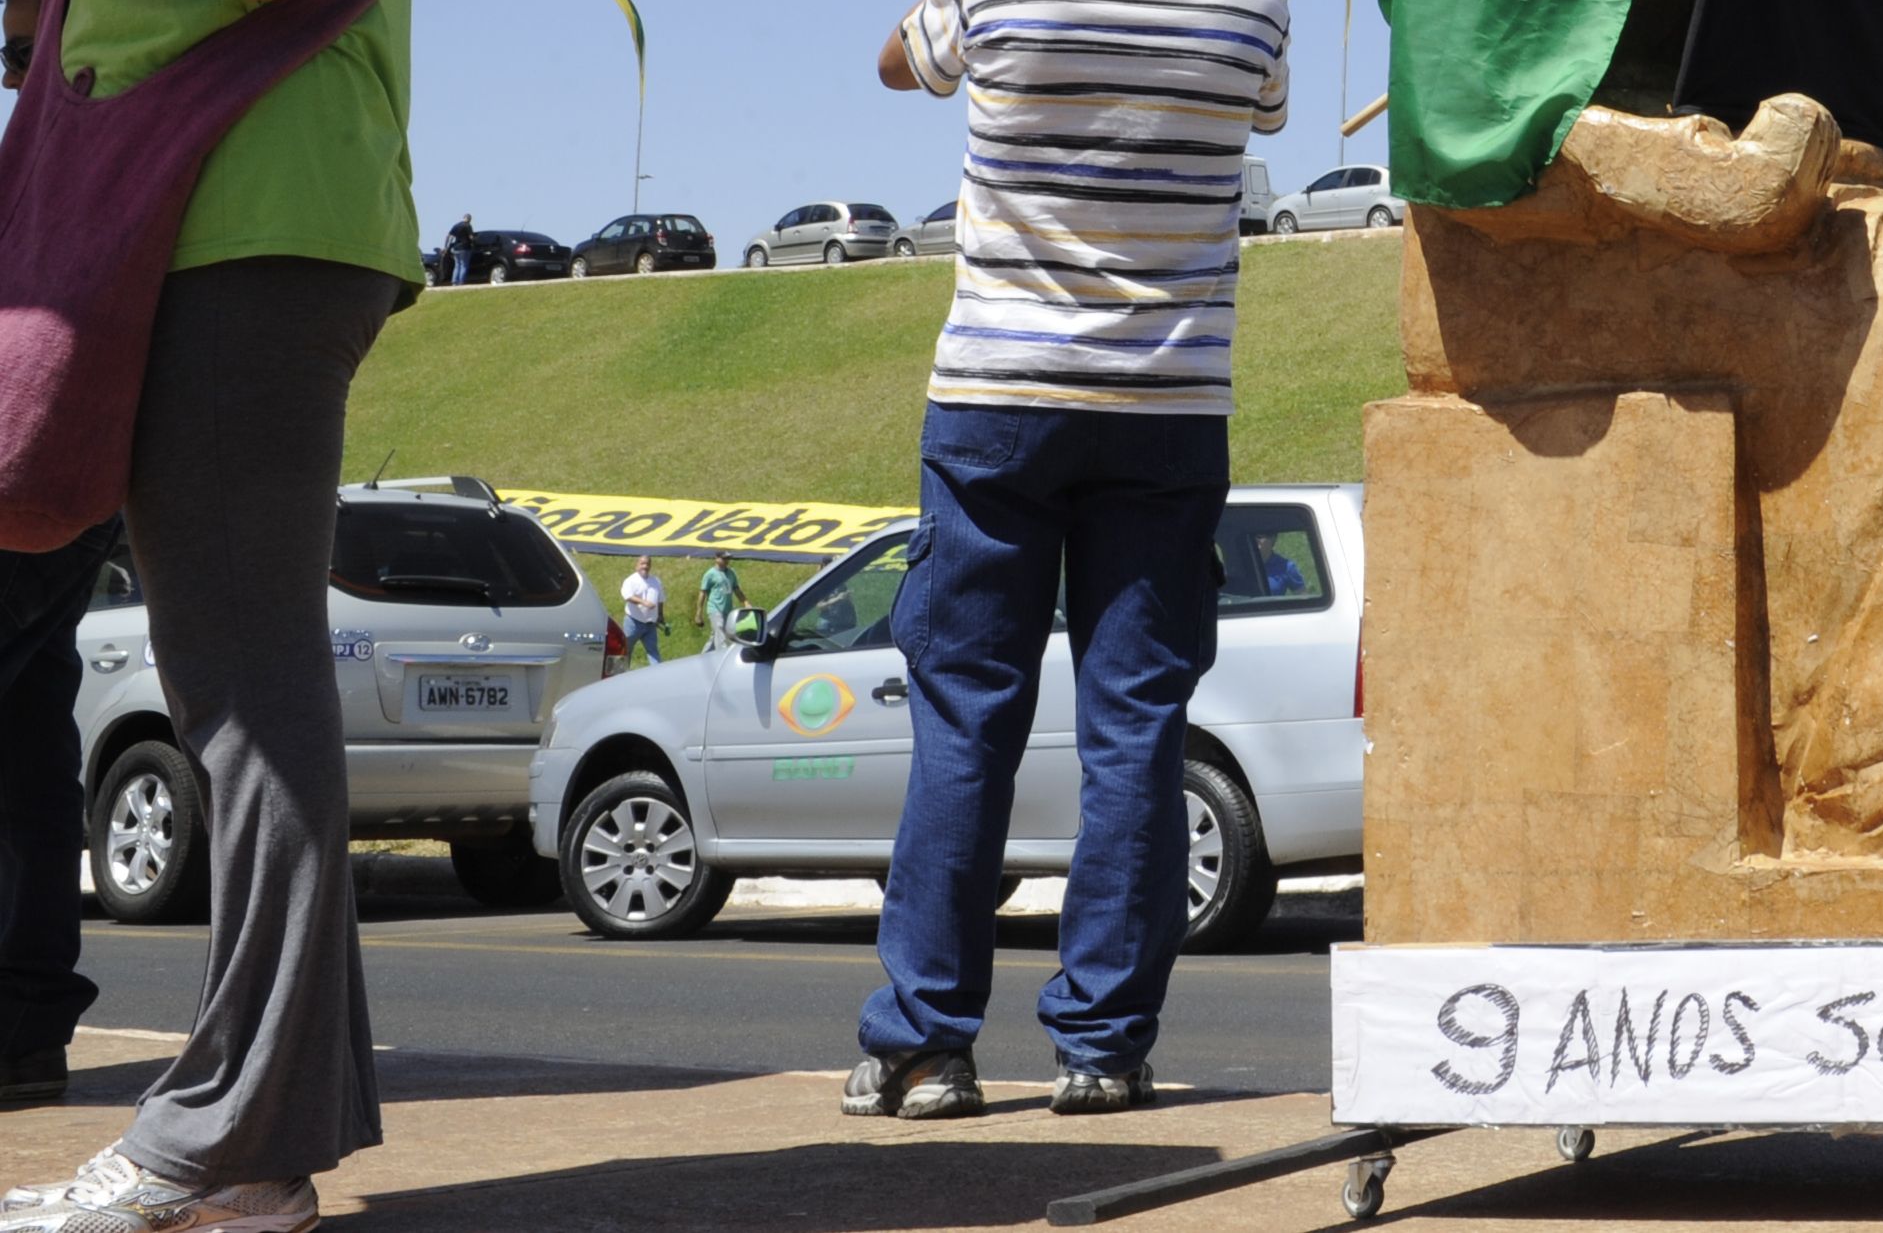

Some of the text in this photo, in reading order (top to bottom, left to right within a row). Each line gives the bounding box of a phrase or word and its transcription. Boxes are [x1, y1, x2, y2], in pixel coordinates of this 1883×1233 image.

[661, 508, 843, 546] Veto
[357, 644, 371, 655] 12
[1432, 982, 1521, 1096] 9
[1544, 986, 1762, 1095] ANOS
